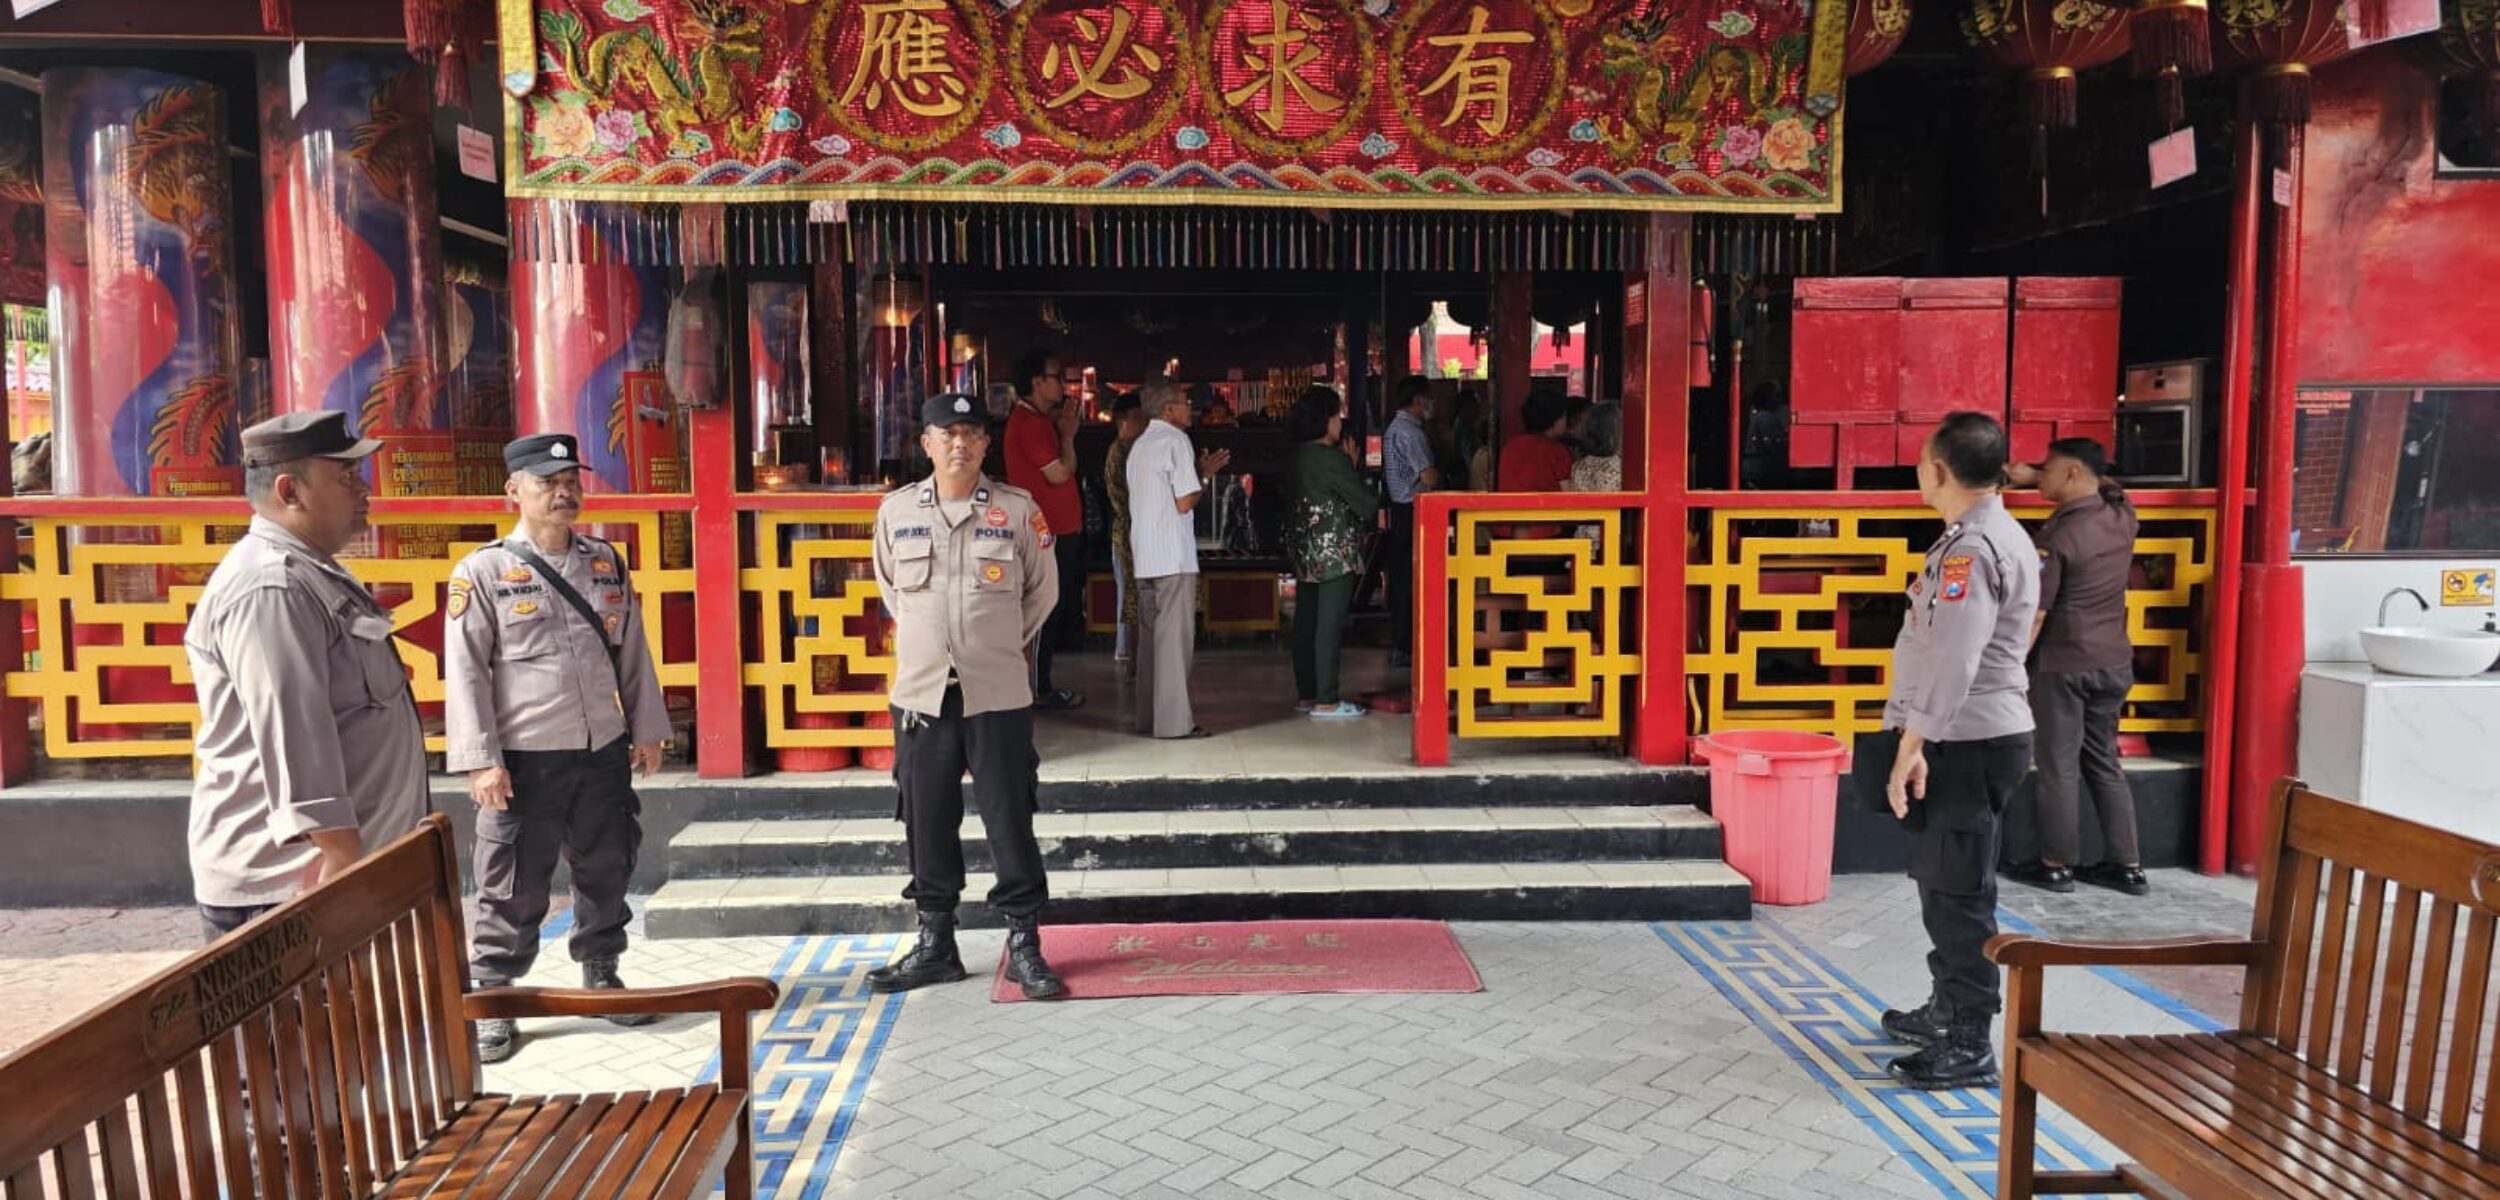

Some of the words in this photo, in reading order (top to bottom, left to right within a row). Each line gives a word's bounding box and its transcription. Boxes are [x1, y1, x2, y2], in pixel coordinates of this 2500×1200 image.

[974, 527, 1014, 540] POLRI
[194, 908, 314, 1005] NUSANTARA
[201, 965, 285, 1036] PASURUAN
